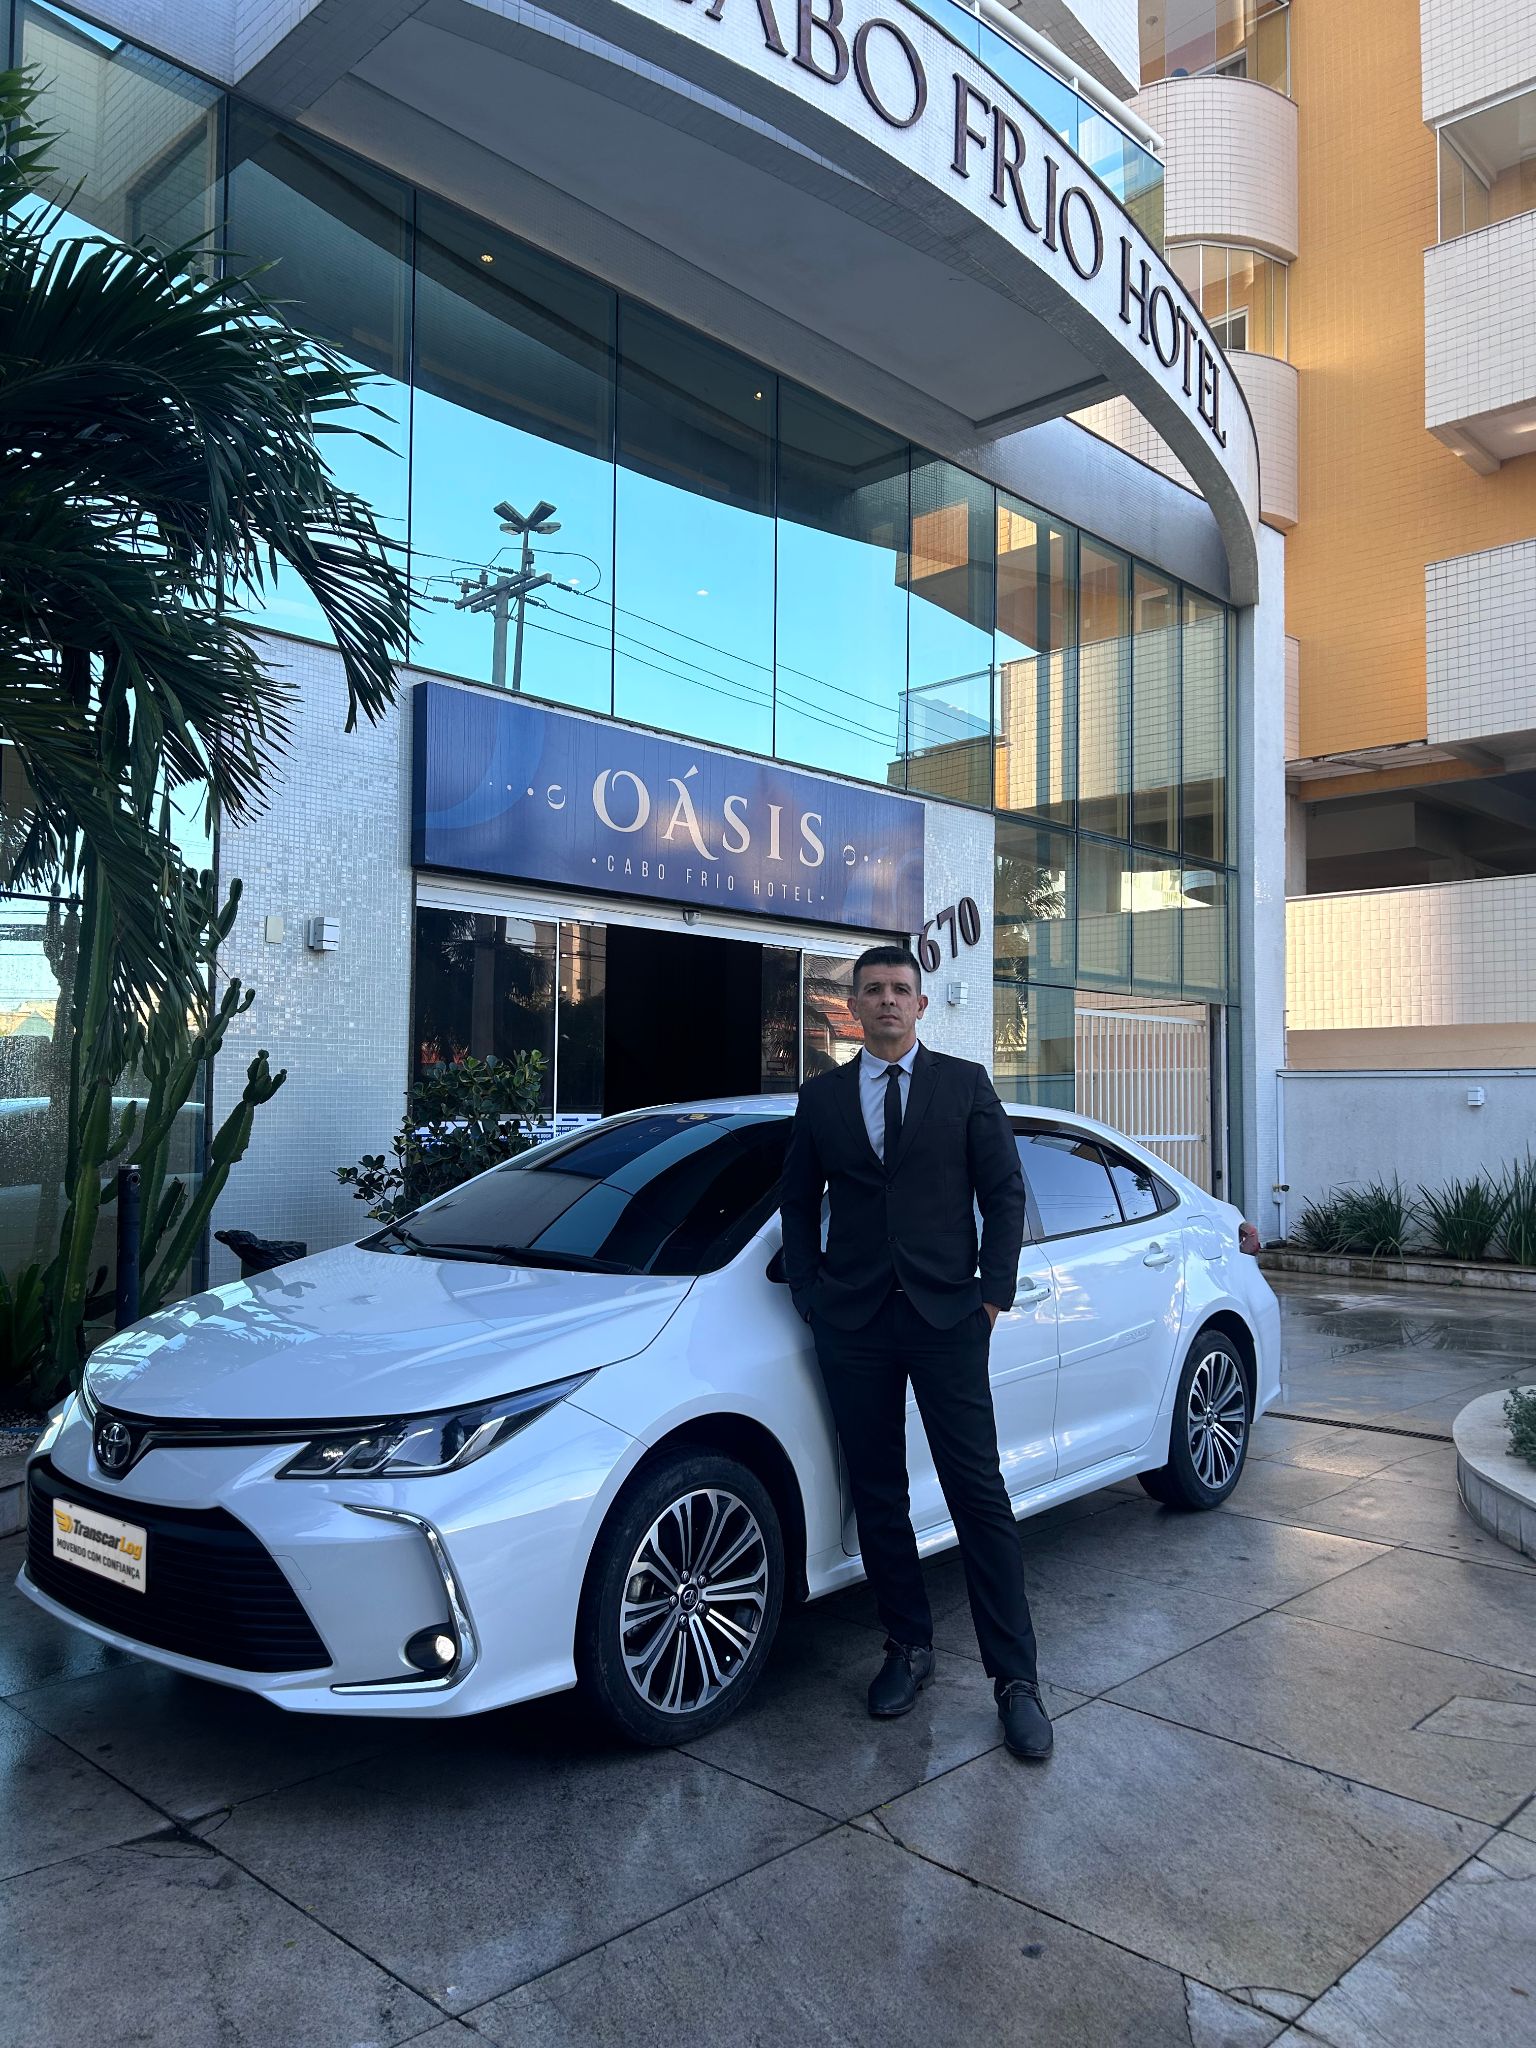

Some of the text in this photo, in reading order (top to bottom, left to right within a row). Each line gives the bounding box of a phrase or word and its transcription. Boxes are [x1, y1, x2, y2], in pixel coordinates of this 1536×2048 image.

[950, 72, 1104, 280] FRIO
[1118, 235, 1227, 449] HOTEL
[592, 764, 825, 867] OÁSIS
[607, 855, 813, 904] CABO FRIO HOTEL
[918, 896, 981, 973] 670
[56, 1537, 141, 1580] MOVENDO COM CONFIANÇA
[74, 1519, 142, 1561] TranscarLog
